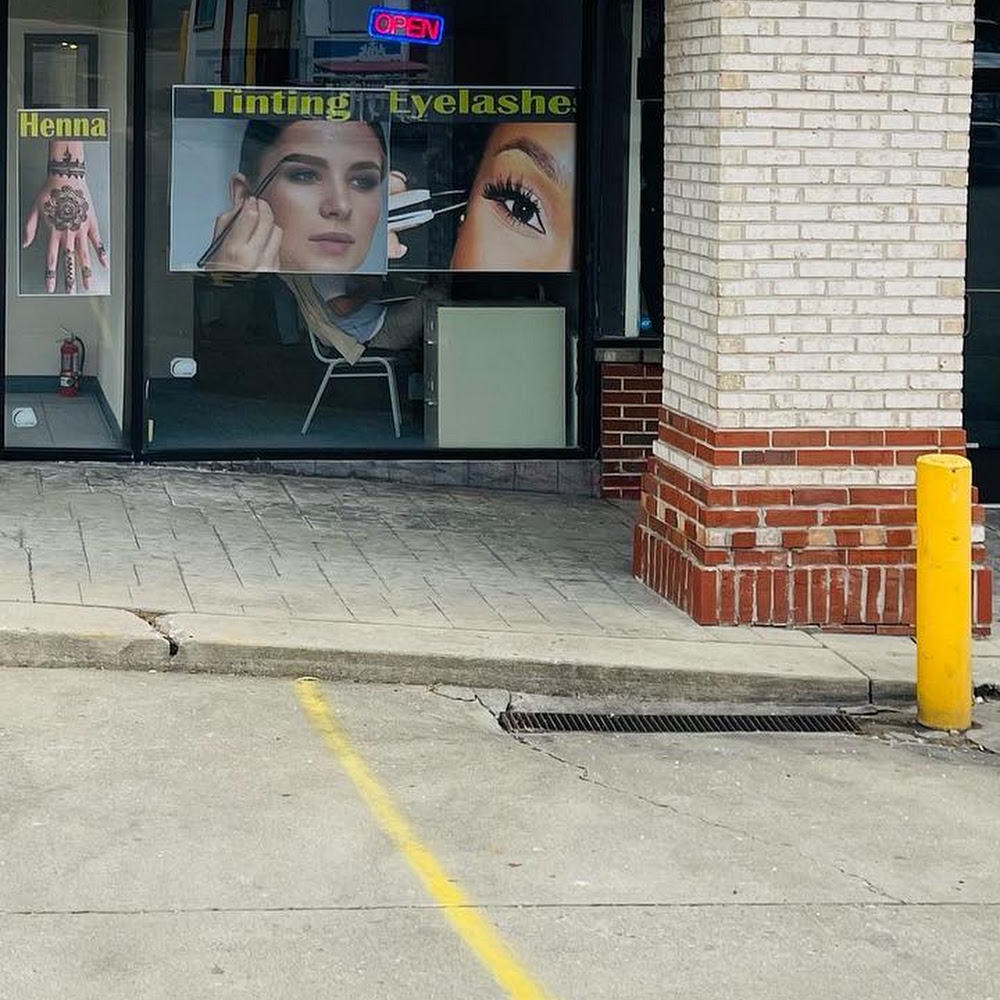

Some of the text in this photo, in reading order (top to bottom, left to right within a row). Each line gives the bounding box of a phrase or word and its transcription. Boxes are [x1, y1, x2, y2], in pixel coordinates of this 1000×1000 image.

[374, 13, 439, 40] OPEN
[206, 88, 351, 121] Tinting
[389, 87, 577, 117] Eyelashe
[20, 112, 107, 137] Henna
